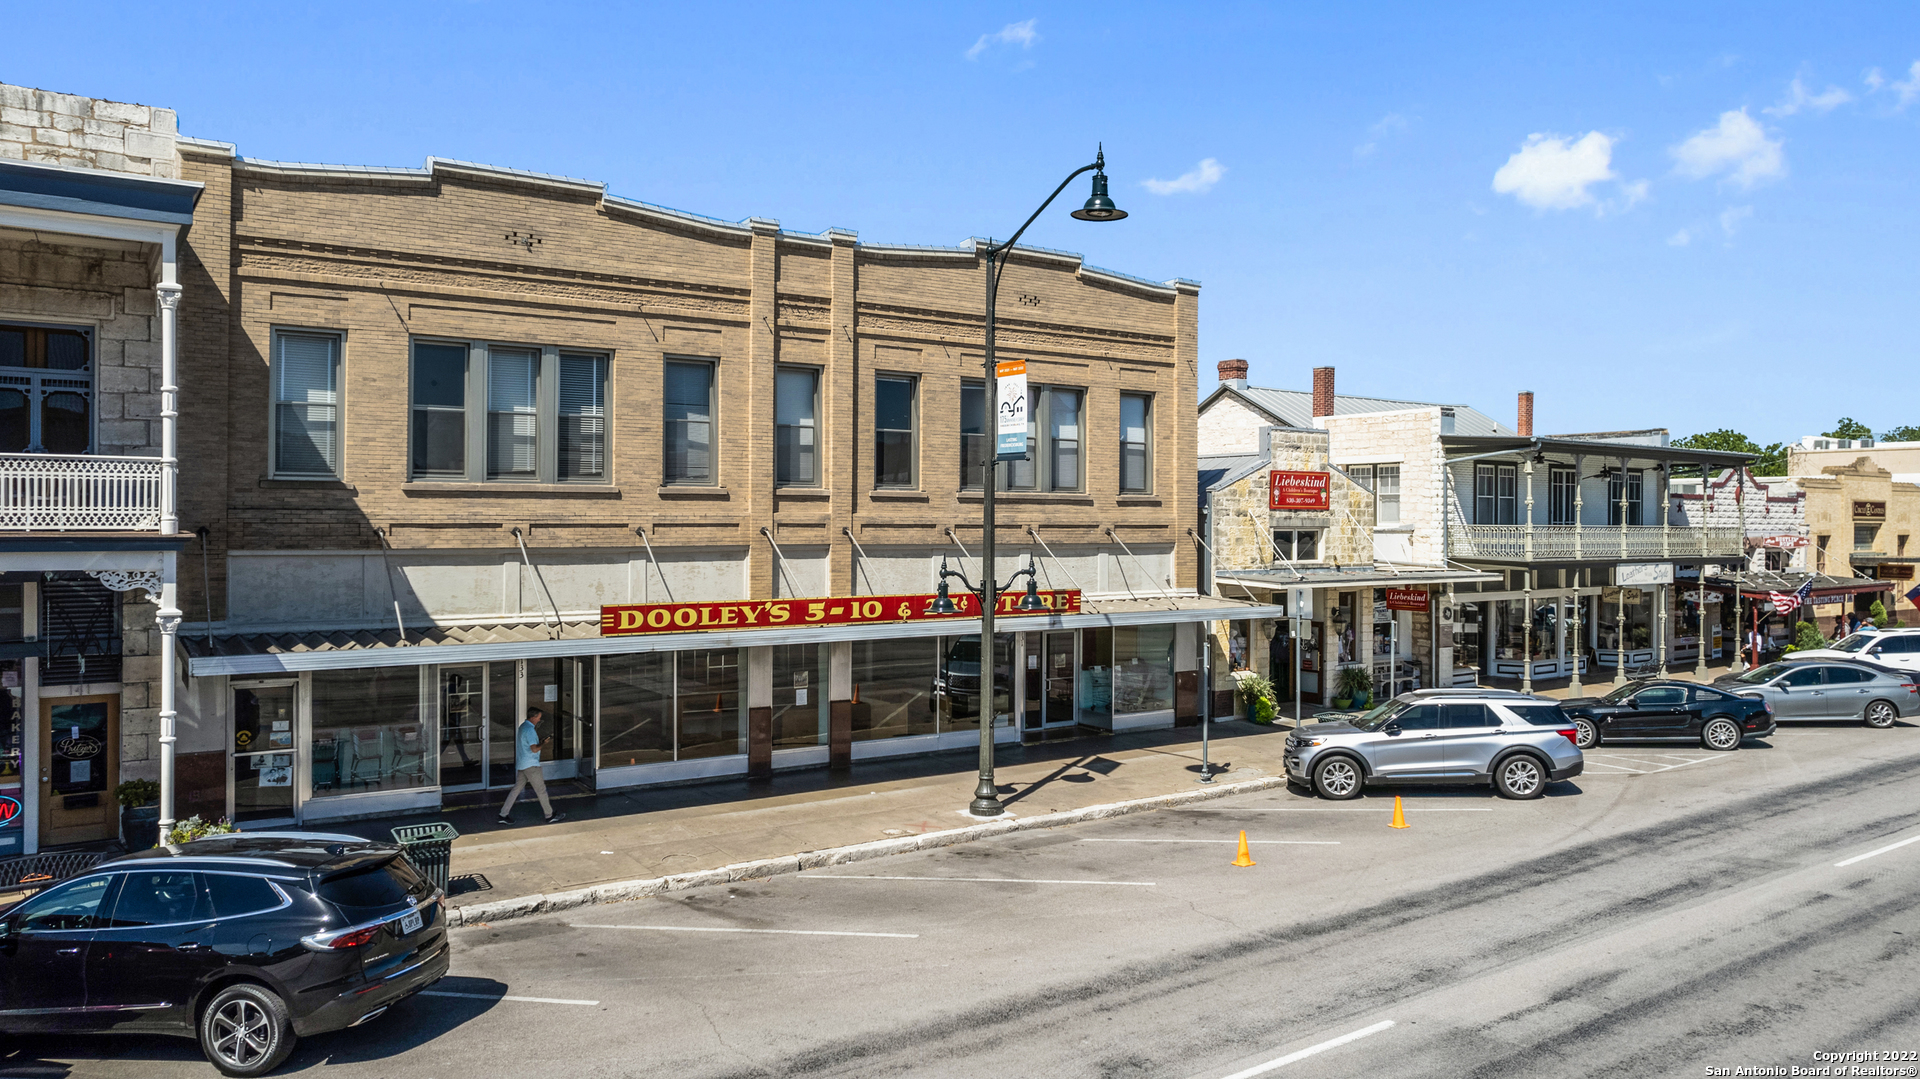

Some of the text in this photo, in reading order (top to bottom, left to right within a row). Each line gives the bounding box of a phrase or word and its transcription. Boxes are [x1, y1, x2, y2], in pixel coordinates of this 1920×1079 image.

[1275, 475, 1326, 487] Liebeskind
[1653, 564, 1669, 581] Style
[1390, 592, 1426, 601] Liebeskind
[617, 601, 790, 629] DOOLEY'S
[805, 601, 883, 621] 5-10
[898, 601, 911, 620] &
[11, 697, 21, 769] BAKERY
